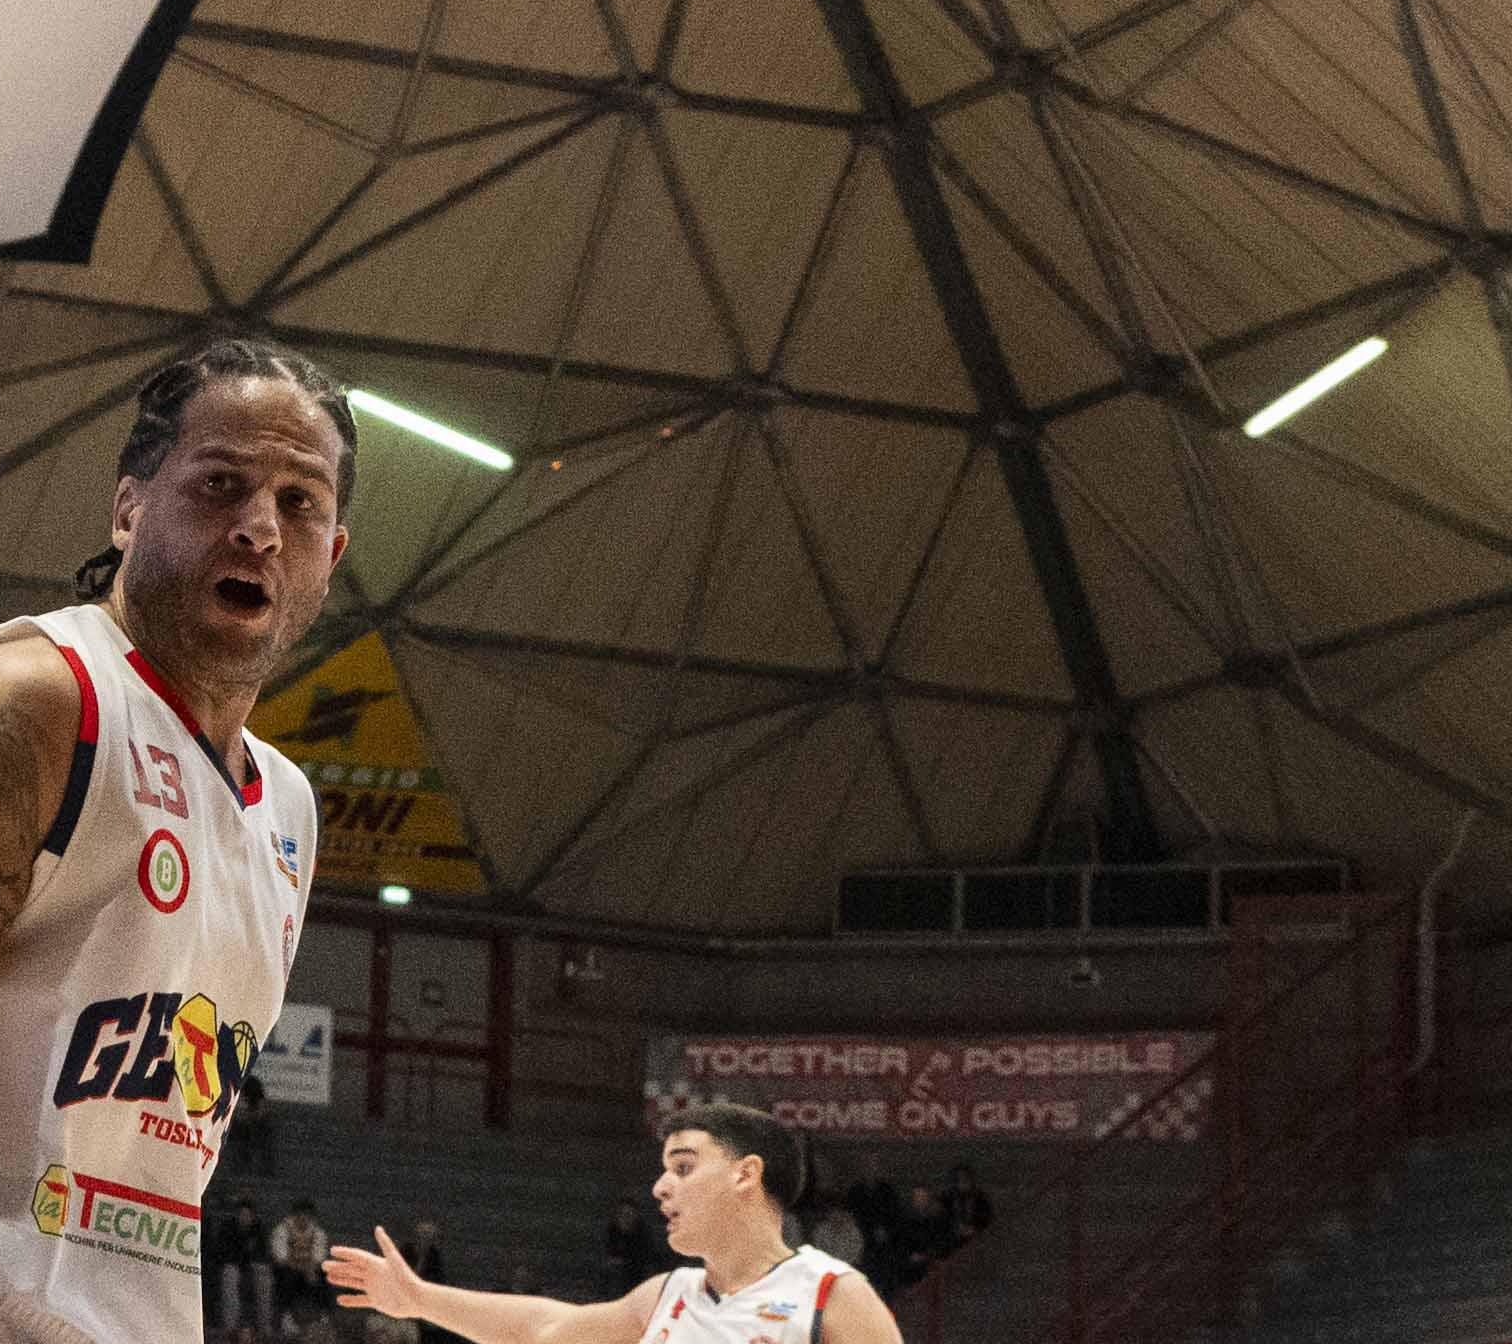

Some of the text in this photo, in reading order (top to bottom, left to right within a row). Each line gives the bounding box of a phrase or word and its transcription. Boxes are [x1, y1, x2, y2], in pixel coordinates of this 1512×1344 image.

[128, 736, 190, 820] 13
[686, 1040, 1176, 1076] TOGETHER POSSIBLE
[776, 1101, 1075, 1130] COME ON GUYS
[72, 1171, 202, 1258] TECNIC
